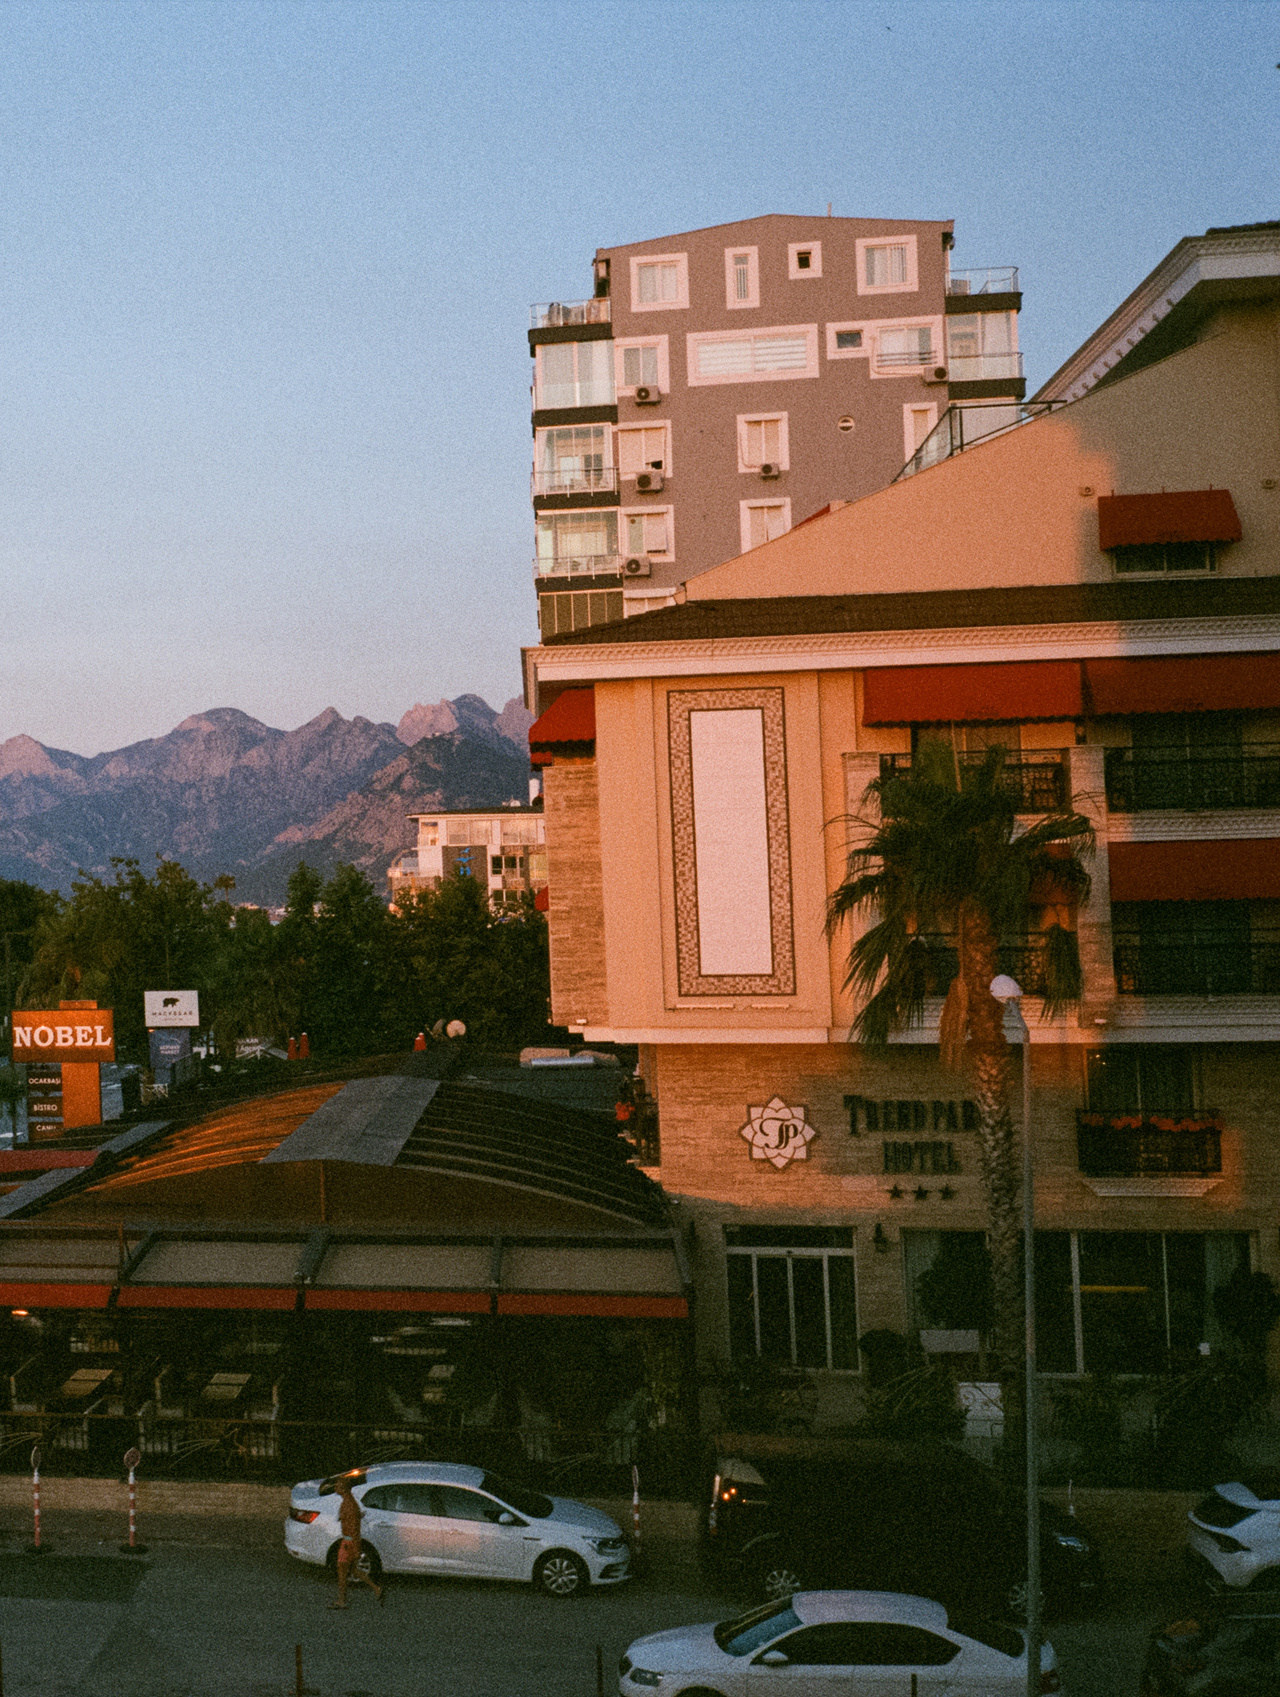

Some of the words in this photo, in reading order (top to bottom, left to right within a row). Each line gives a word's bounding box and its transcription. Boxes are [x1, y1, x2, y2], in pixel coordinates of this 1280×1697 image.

[13, 1025, 112, 1047] NOBEL
[843, 1095, 925, 1137] TREND
[883, 1141, 961, 1174] HOTEL
